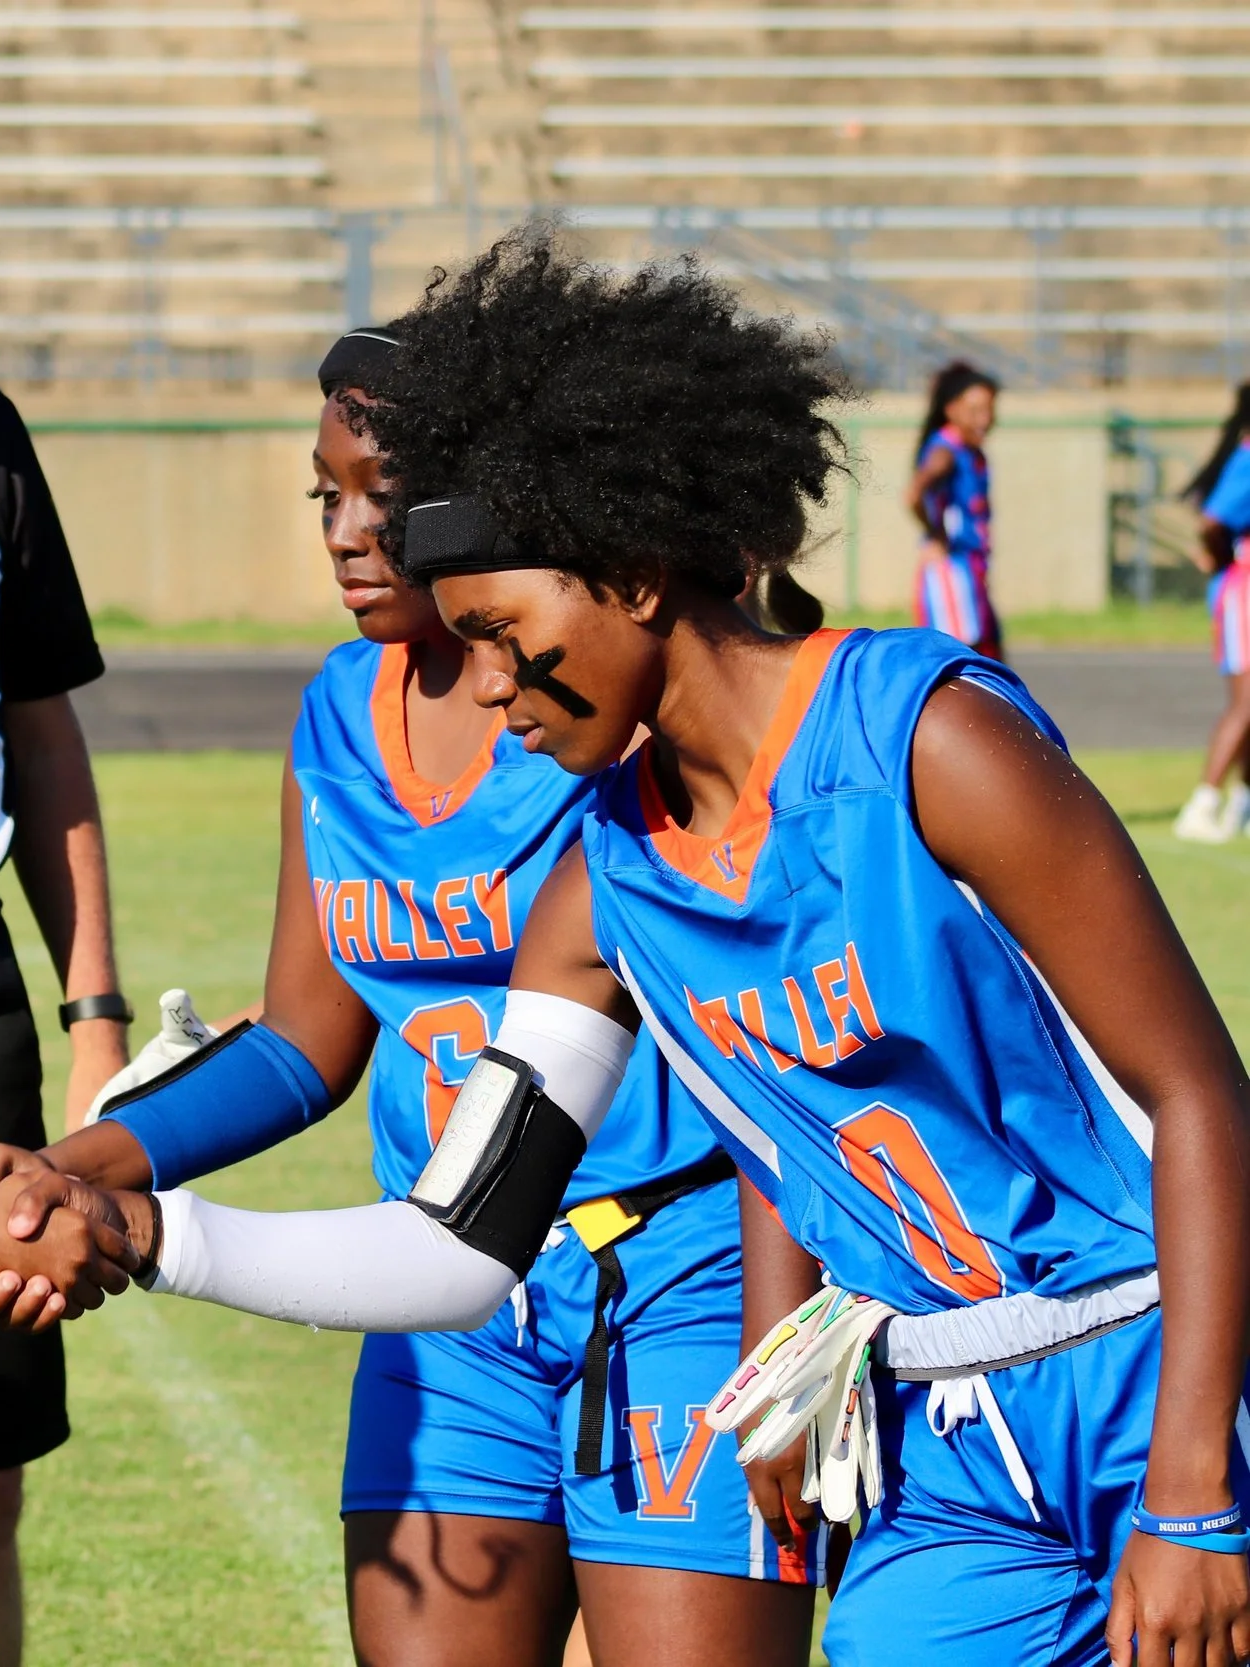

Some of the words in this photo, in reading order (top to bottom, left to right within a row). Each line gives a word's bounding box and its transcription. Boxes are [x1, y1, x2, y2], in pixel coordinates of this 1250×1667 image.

[428, 790, 453, 819] V
[710, 840, 739, 885] V
[830, 1101, 1007, 1305] 0
[621, 1404, 720, 1522] V
[1158, 1521, 1197, 1532] UNION
